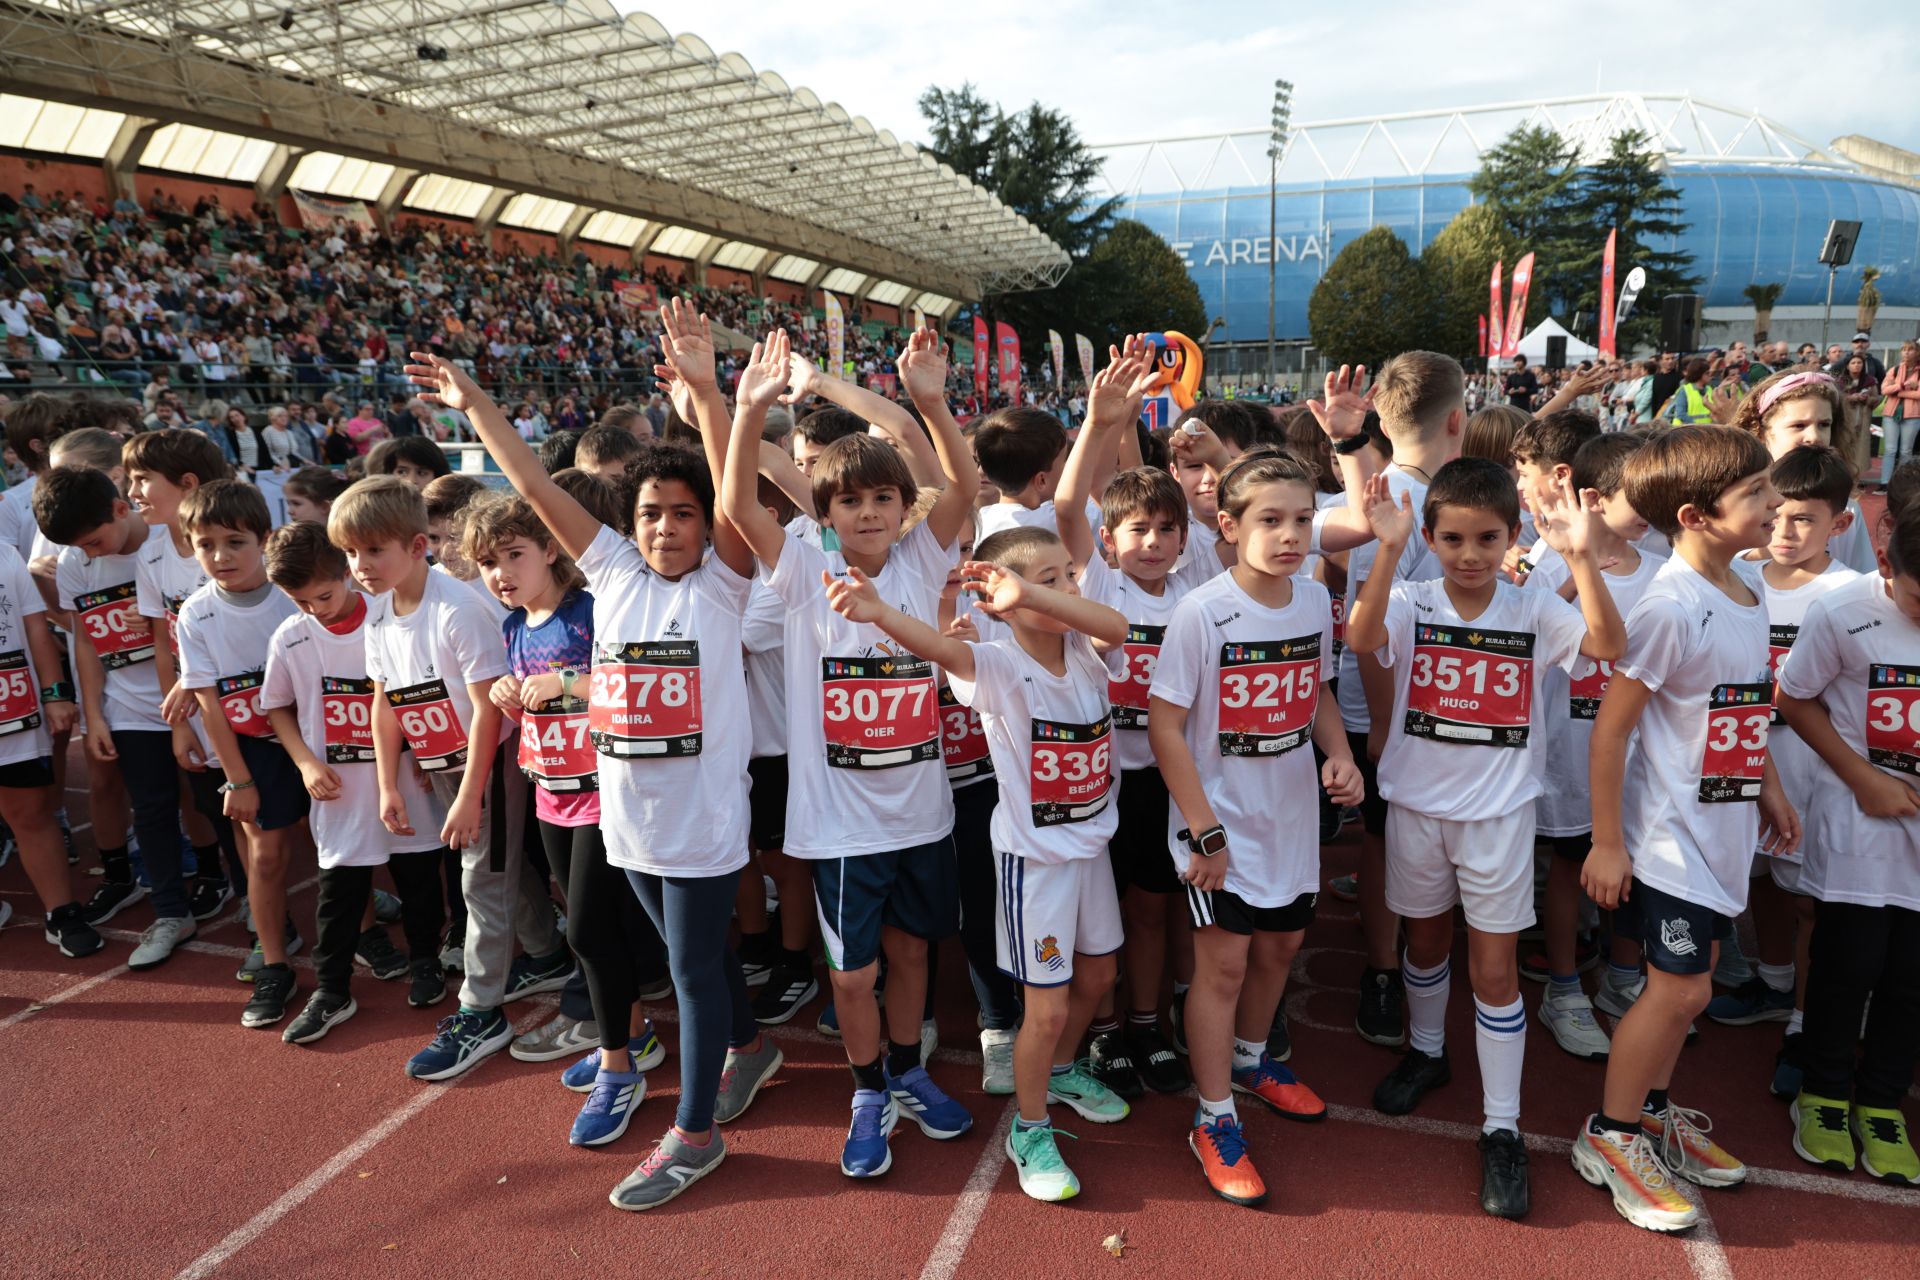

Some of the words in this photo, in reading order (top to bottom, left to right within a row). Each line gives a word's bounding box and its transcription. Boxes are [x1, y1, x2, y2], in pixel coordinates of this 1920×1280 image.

[1205, 235, 1323, 266] ARENA
[1143, 400, 1158, 432] 1
[85, 603, 137, 638] 30
[1847, 621, 1873, 636] luanvi
[1508, 639, 1527, 647] KUTXA
[591, 672, 688, 708] 3278
[1222, 665, 1315, 708] 3215
[1413, 653, 1520, 697] 3513
[325, 700, 374, 727] 30
[825, 683, 930, 722] 3077
[1268, 711, 1286, 723] IAN
[1439, 696, 1480, 710] HUGO
[611, 714, 653, 725] IDAIRA
[864, 726, 895, 738] OIER
[1709, 715, 1769, 751] 33
[1033, 742, 1109, 782] 336
[1068, 775, 1106, 795] BEÑAT
